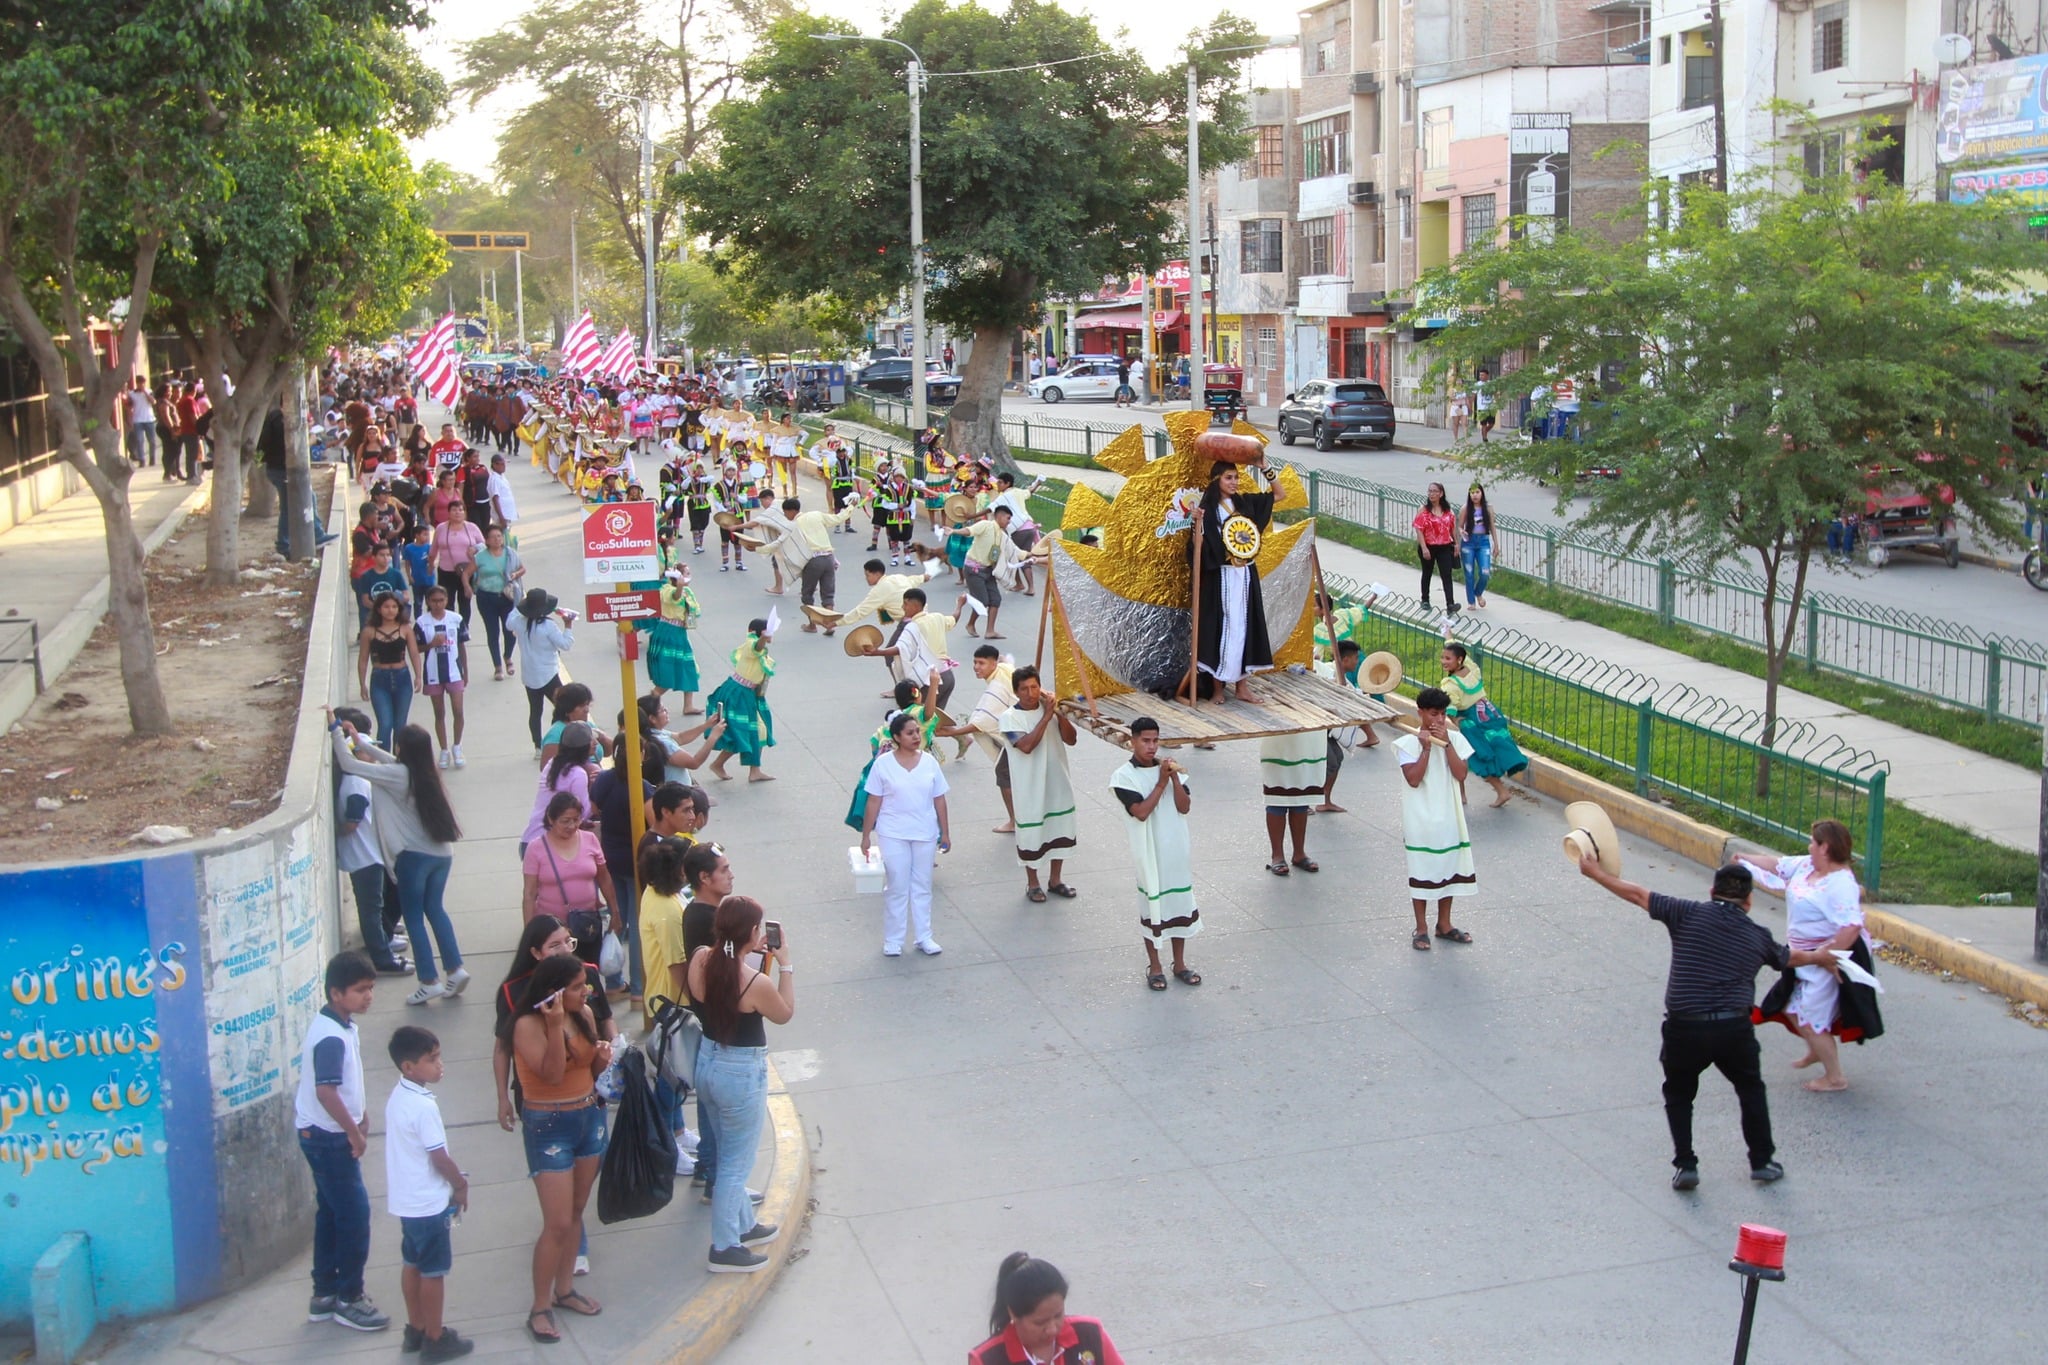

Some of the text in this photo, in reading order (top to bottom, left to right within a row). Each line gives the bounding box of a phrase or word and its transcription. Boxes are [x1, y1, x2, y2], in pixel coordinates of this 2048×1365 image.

[1511, 113, 1571, 128] VENTA Y RECARGA DE
[440, 452, 461, 462] FOX
[588, 537, 652, 553] CajaSullana
[612, 563, 645, 571] SULLANA
[605, 594, 643, 604] Transversal
[11, 941, 187, 1005] orines
[92, 1069, 152, 1112] de
